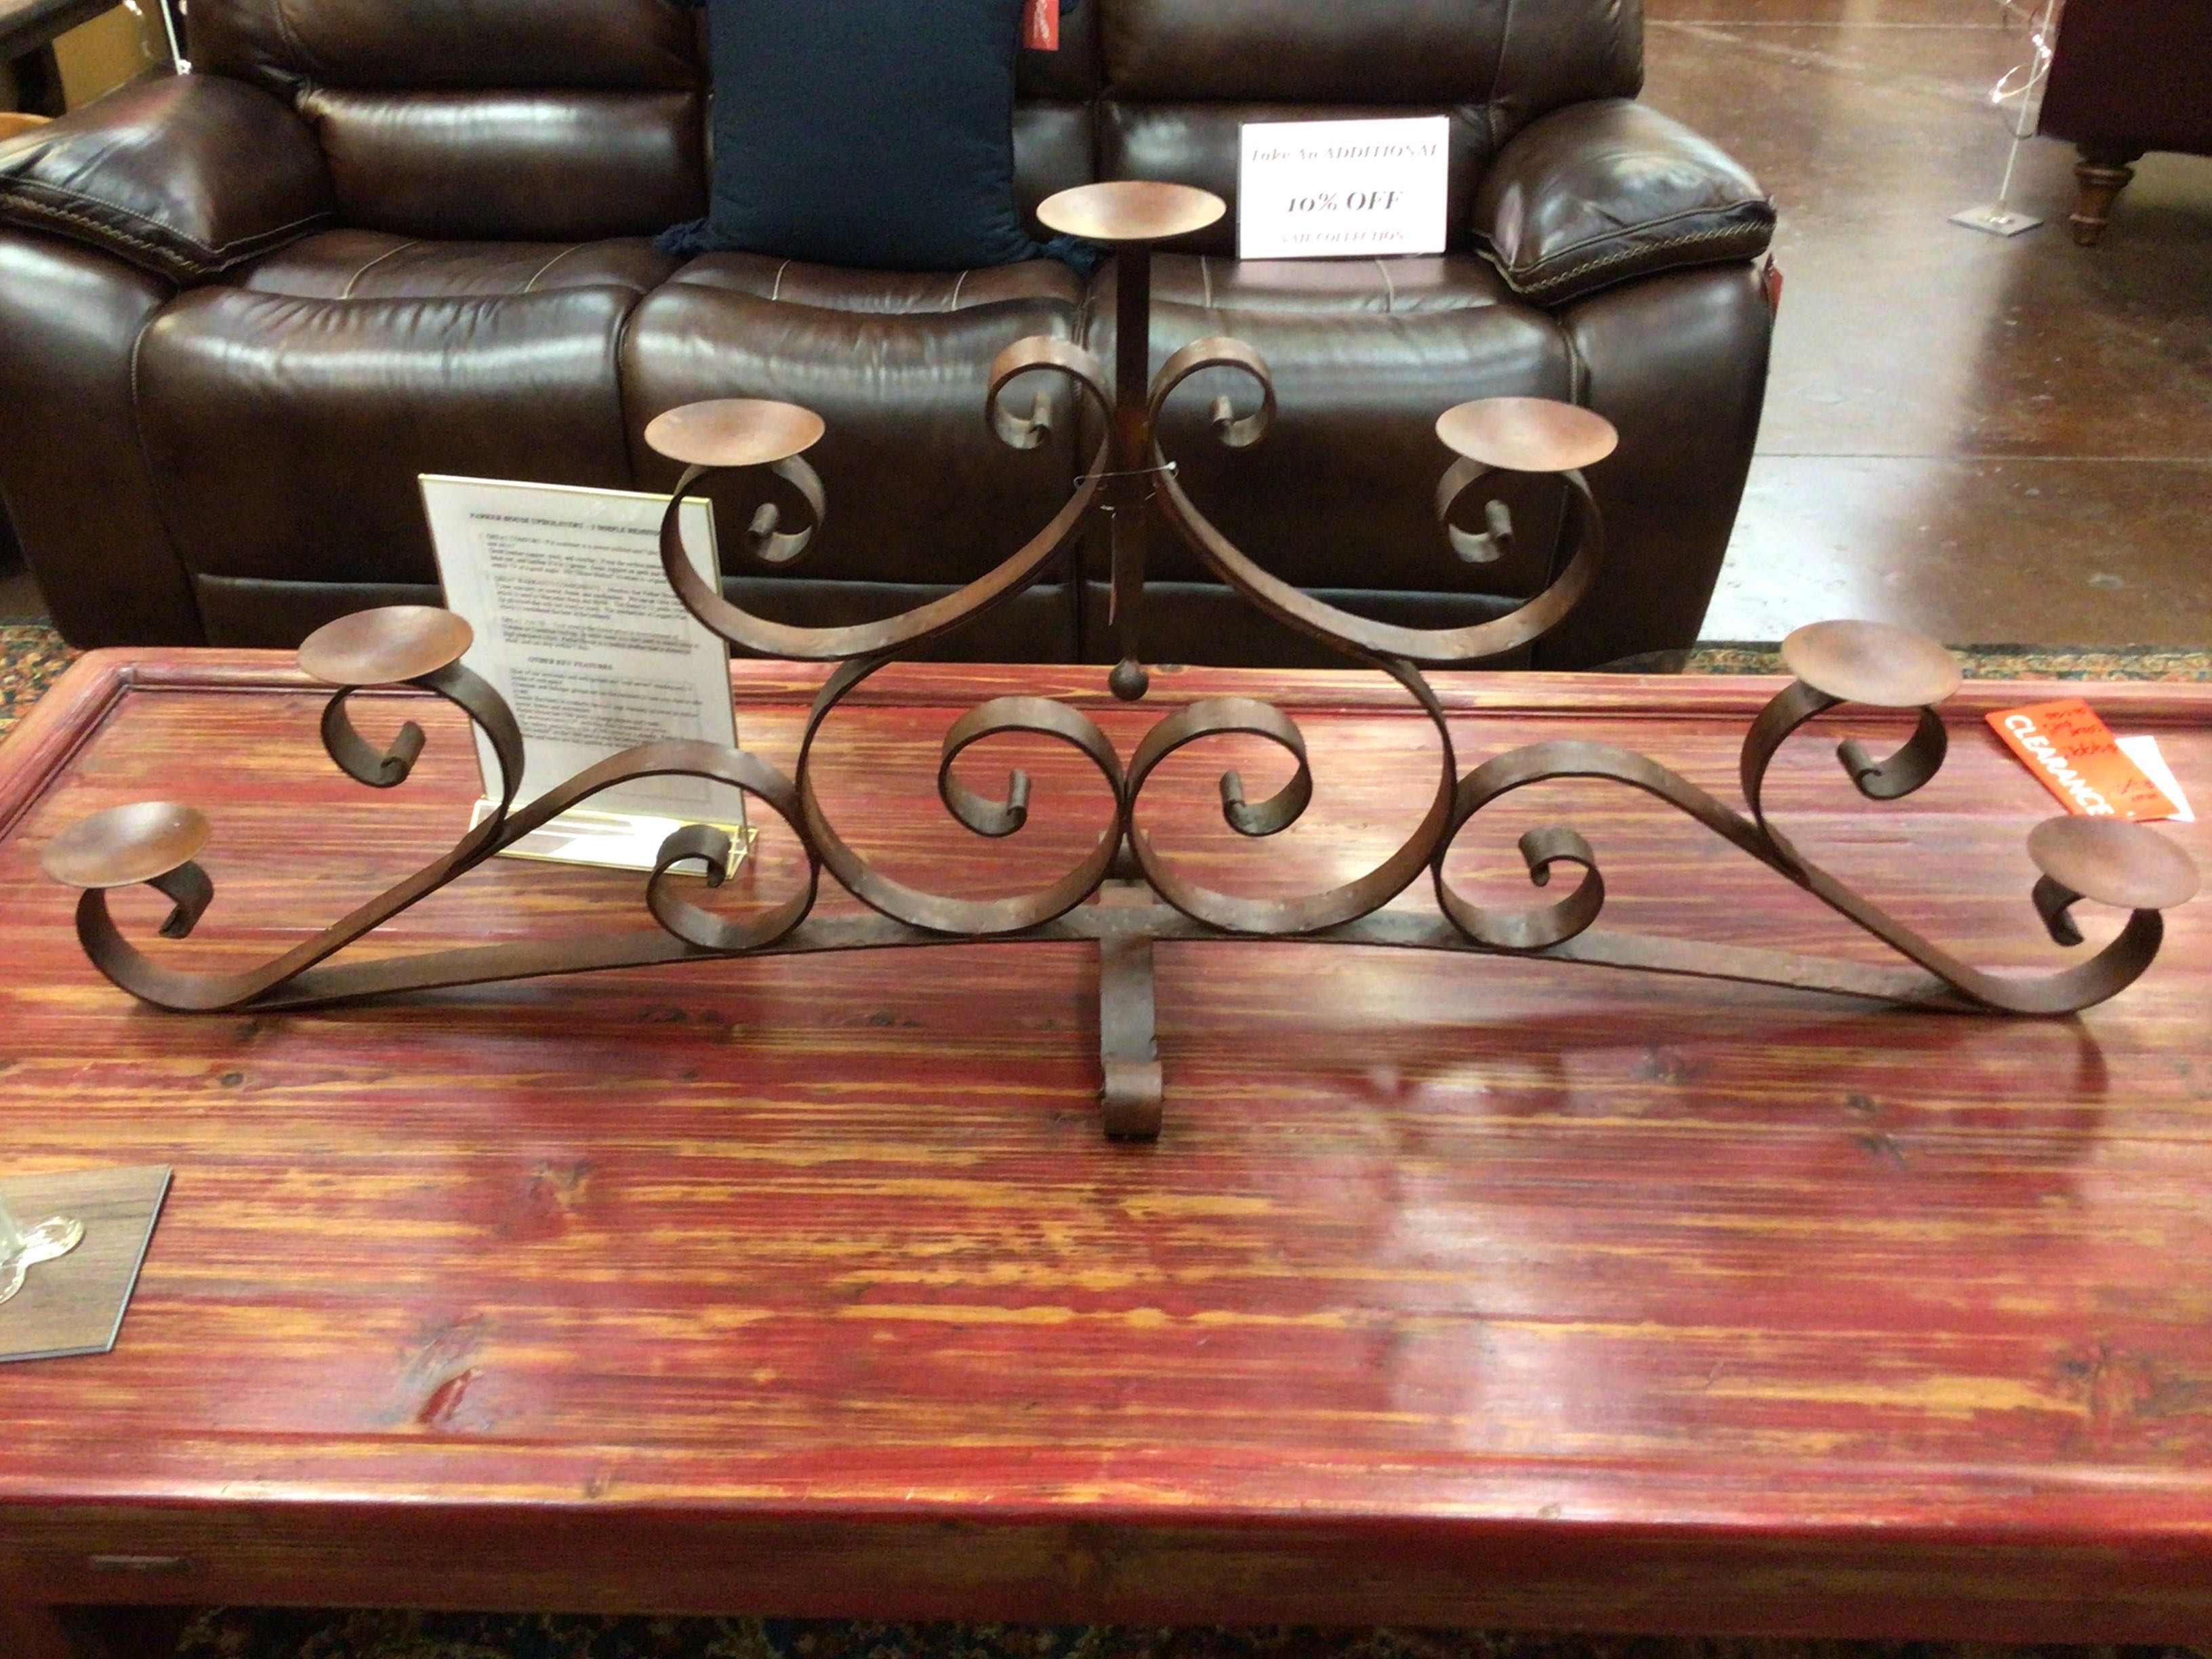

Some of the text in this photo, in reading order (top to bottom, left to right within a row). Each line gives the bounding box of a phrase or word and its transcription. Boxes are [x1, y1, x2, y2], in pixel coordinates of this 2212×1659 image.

[1251, 143, 1438, 161] Take An ADDITIONAL
[1286, 190, 1404, 213] 10% OFF
[2004, 715, 2115, 816] CLEARANCE
